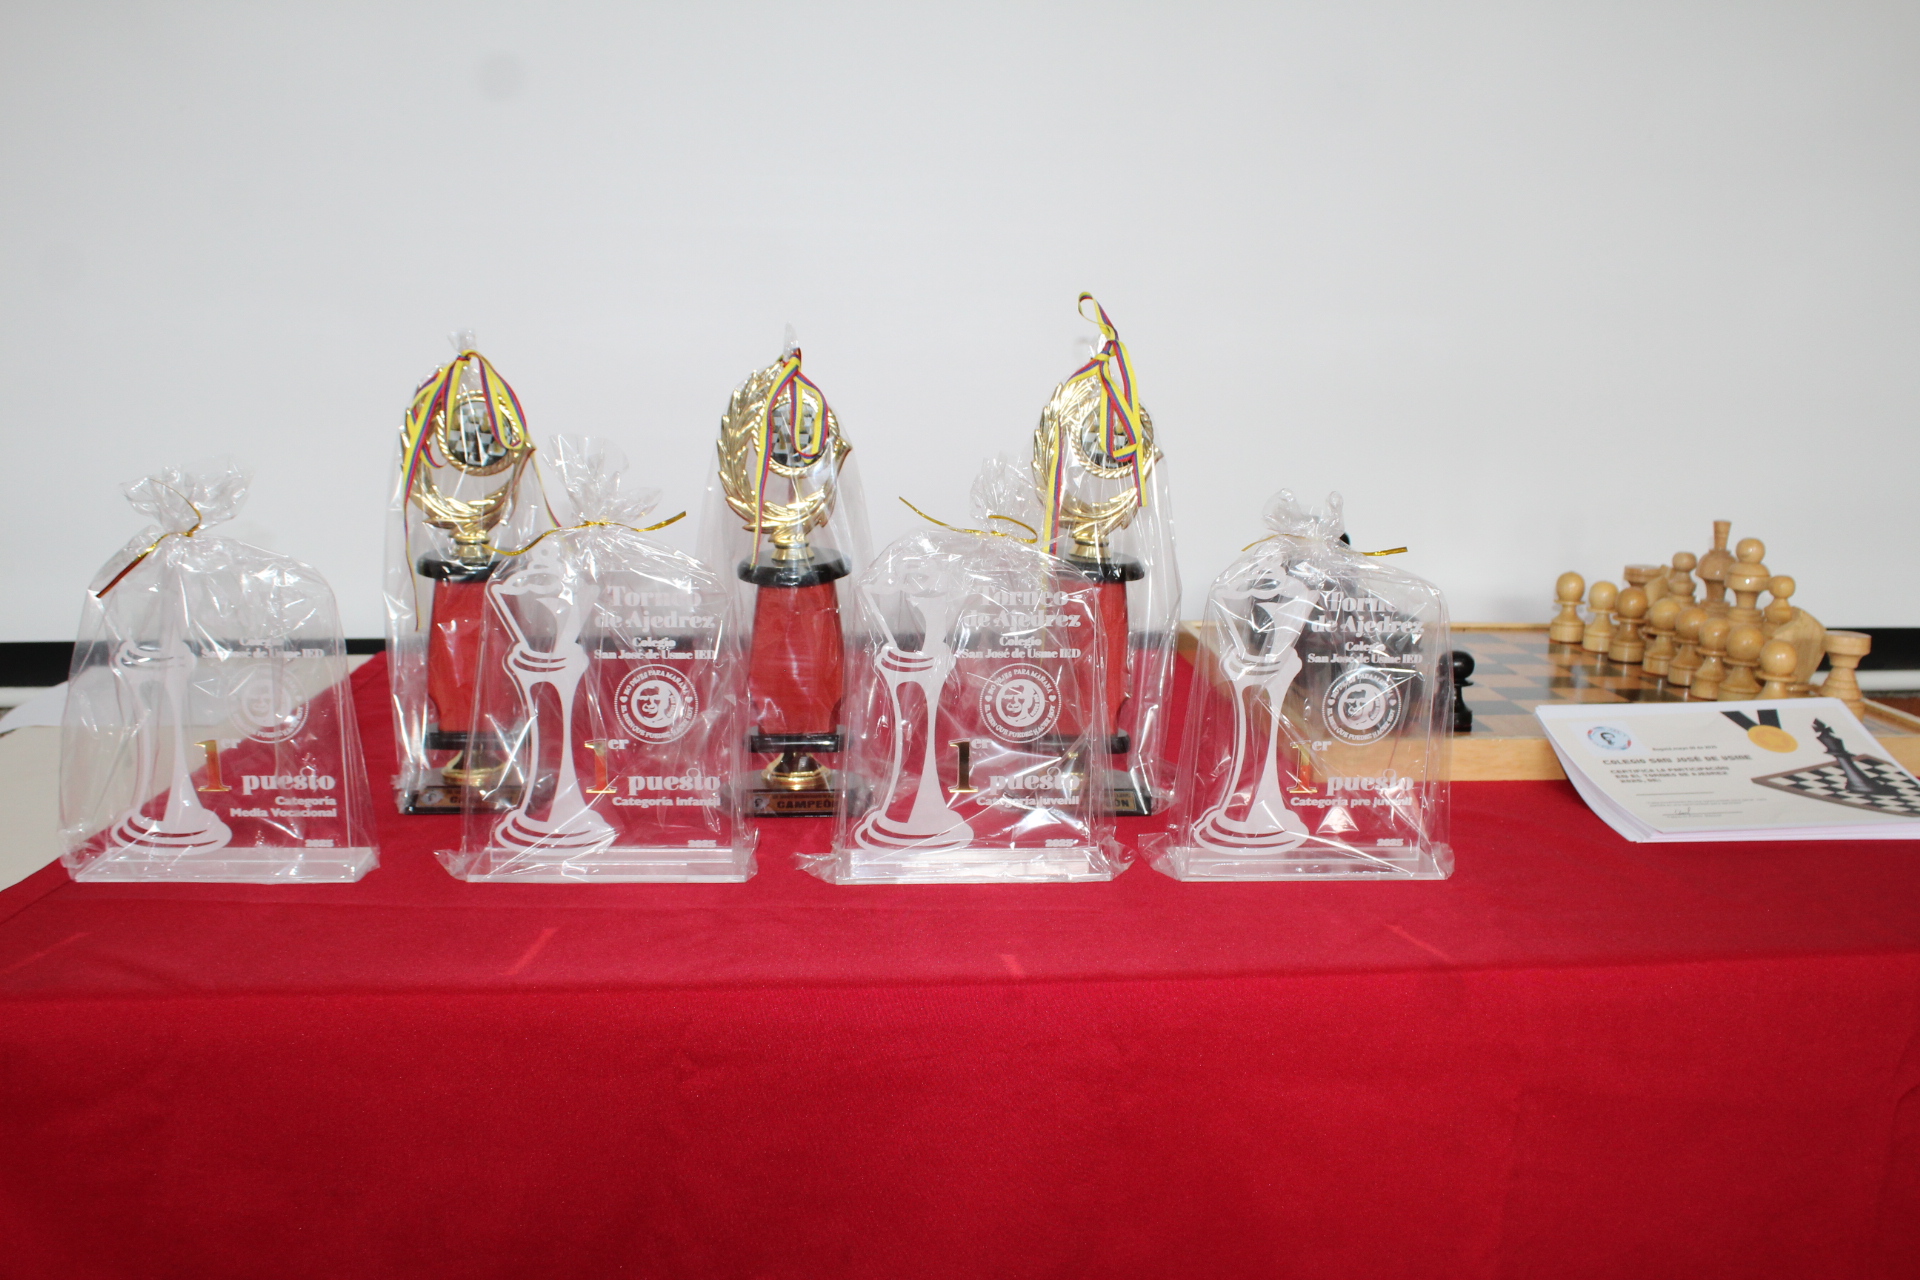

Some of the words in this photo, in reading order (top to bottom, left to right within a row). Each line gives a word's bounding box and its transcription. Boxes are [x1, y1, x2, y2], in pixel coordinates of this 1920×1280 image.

[977, 585, 1069, 606] Torneo
[594, 611, 623, 628] de
[625, 610, 716, 633] Ajedrez
[964, 610, 991, 628] de
[993, 610, 1081, 631] Ajedrez
[1340, 615, 1424, 637] Ajedrez
[632, 637, 676, 650] Colegio
[999, 636, 1042, 648] Colegio
[594, 649, 617, 659] San
[645, 648, 660, 659] de
[661, 649, 693, 660] Usme
[695, 649, 716, 660] IED
[961, 649, 983, 659] San
[984, 648, 1010, 659] José
[1011, 648, 1026, 659] de
[1027, 649, 1058, 659] Usme
[1059, 649, 1081, 659] IED
[1308, 653, 1329, 663] San
[1402, 654, 1424, 664] IED
[241, 768, 336, 795] puesto
[627, 769, 721, 796] puesto
[989, 767, 1080, 795] puesto
[275, 796, 337, 807] Categoría
[612, 796, 673, 808] Categoría
[676, 796, 721, 807] infantil
[1037, 796, 1079, 808] juvenil
[1290, 797, 1348, 808] Categoría
[1351, 798, 1370, 808] pre
[229, 807, 269, 818] Media
[270, 807, 337, 818] Vocacional
